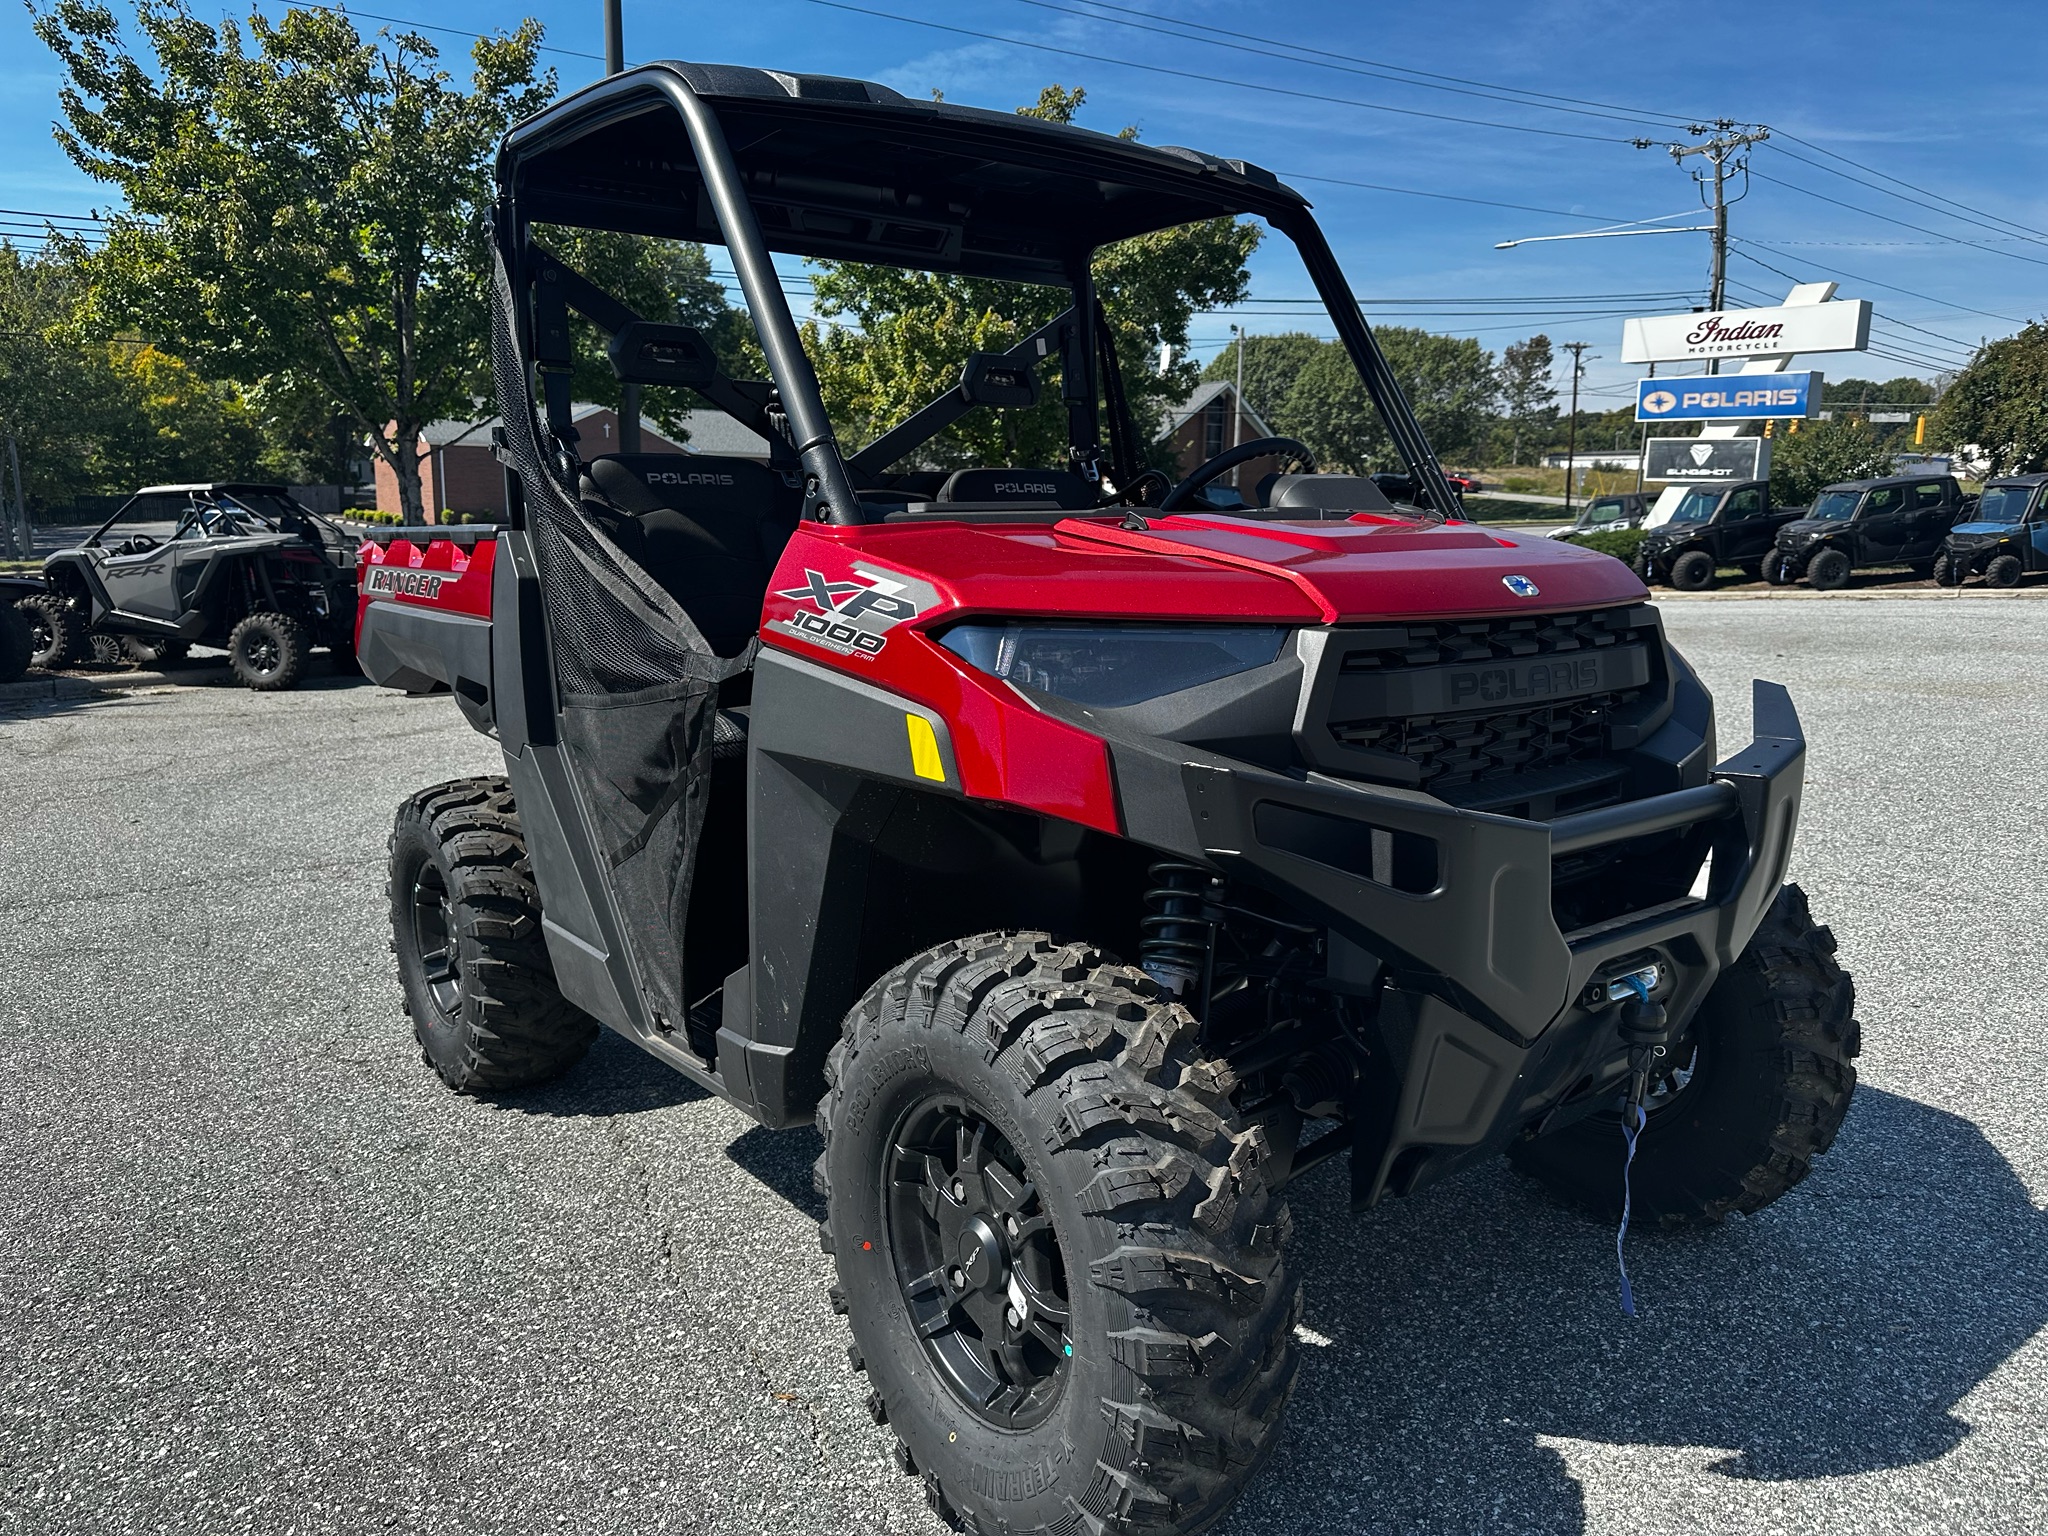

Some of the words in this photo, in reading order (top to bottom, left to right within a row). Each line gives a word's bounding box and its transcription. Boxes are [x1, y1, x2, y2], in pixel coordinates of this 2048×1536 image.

[1686, 316, 1784, 345] Indian
[1689, 342, 1778, 353] MOTORCYCLE
[1682, 389, 1797, 409] POLARIS
[646, 472, 735, 486] POLARIS
[1666, 468, 1733, 476] SLINGSHOT
[994, 482, 1057, 495] POLARIS
[104, 563, 167, 582] RZR
[371, 568, 442, 600] RANGER
[773, 567, 918, 622] XP
[788, 628, 809, 640] DUAL
[809, 636, 854, 655] OVERHEAD
[854, 651, 875, 662] CAM
[793, 609, 888, 655] 1000
[1450, 658, 1599, 705] POLARIS
[845, 1088, 871, 1136] PRO
[864, 1047, 917, 1098] ARMOR
[971, 1426, 1076, 1502] X-TERRAIN
